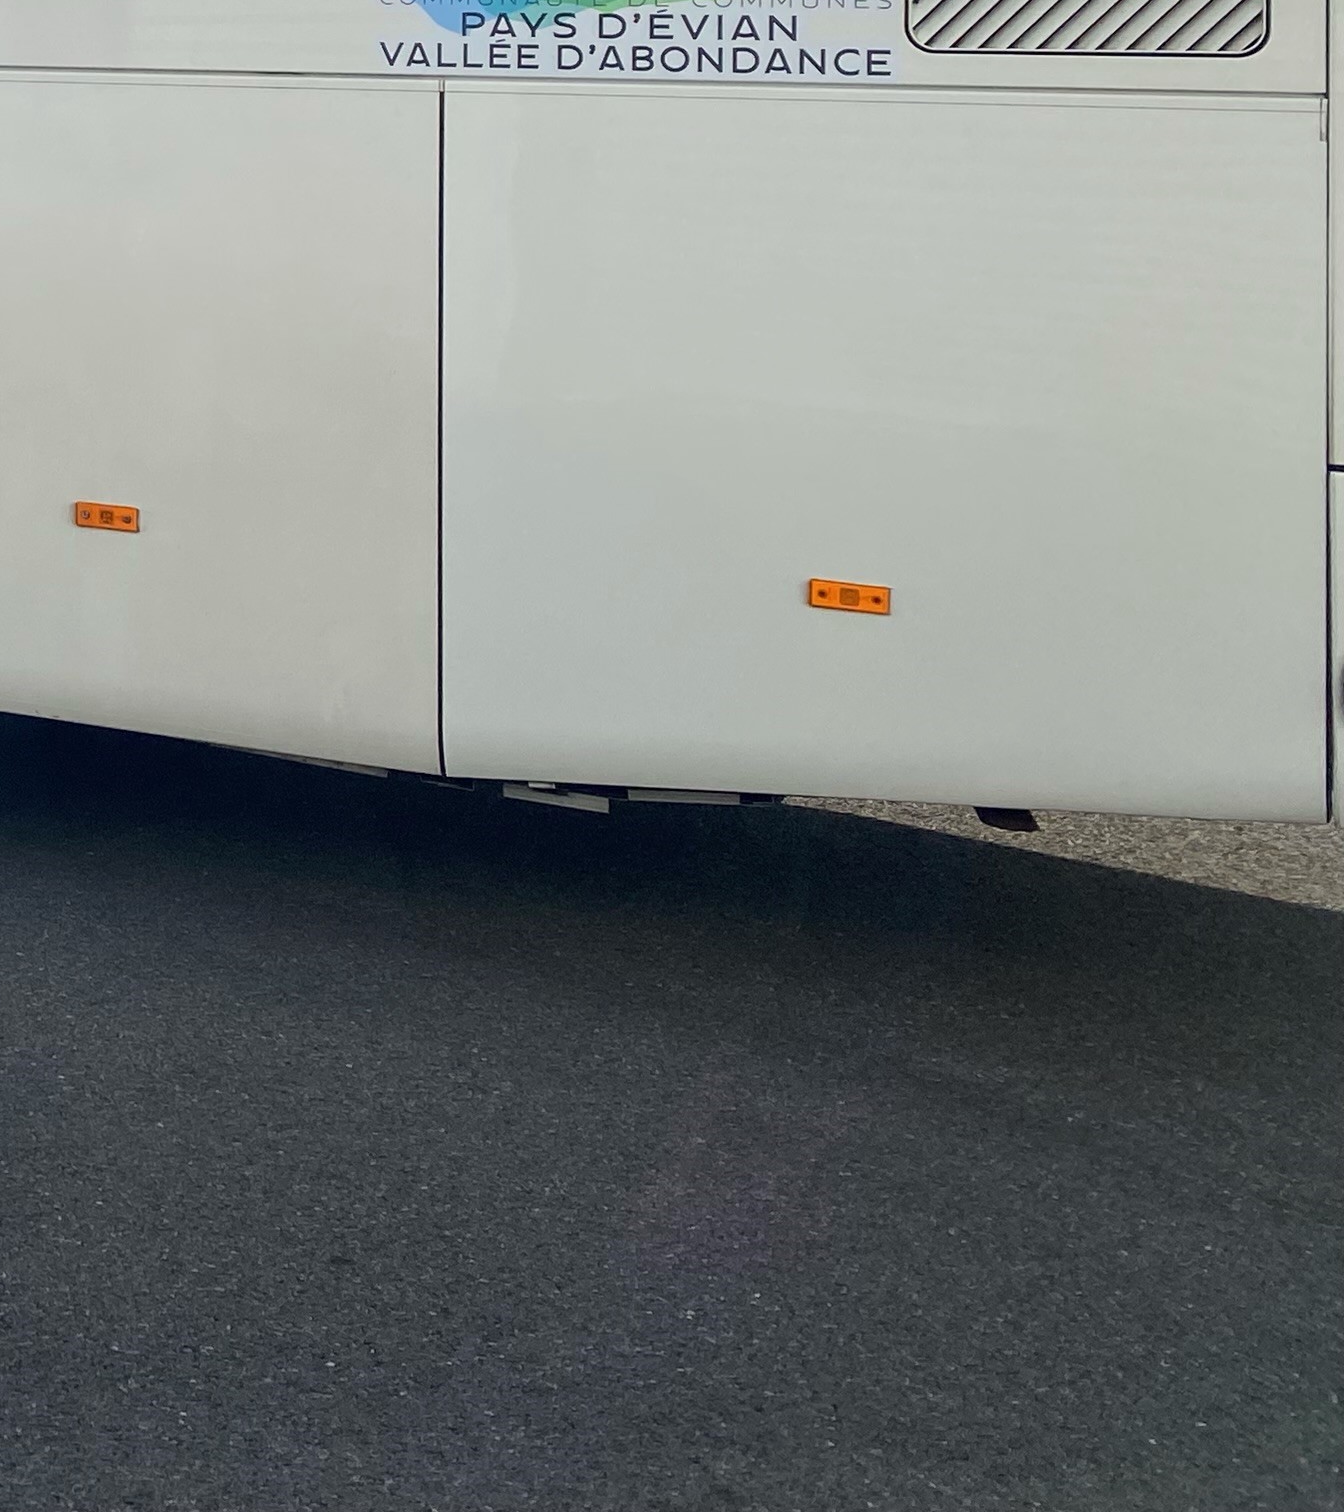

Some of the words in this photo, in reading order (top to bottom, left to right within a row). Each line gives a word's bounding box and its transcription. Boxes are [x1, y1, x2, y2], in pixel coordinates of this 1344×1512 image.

[461, 11, 577, 39] PAYS
[598, 9, 798, 42] D'ÉVIAN
[379, 38, 540, 70] VALLÉE
[557, 44, 892, 77] D'ABONDANCE
